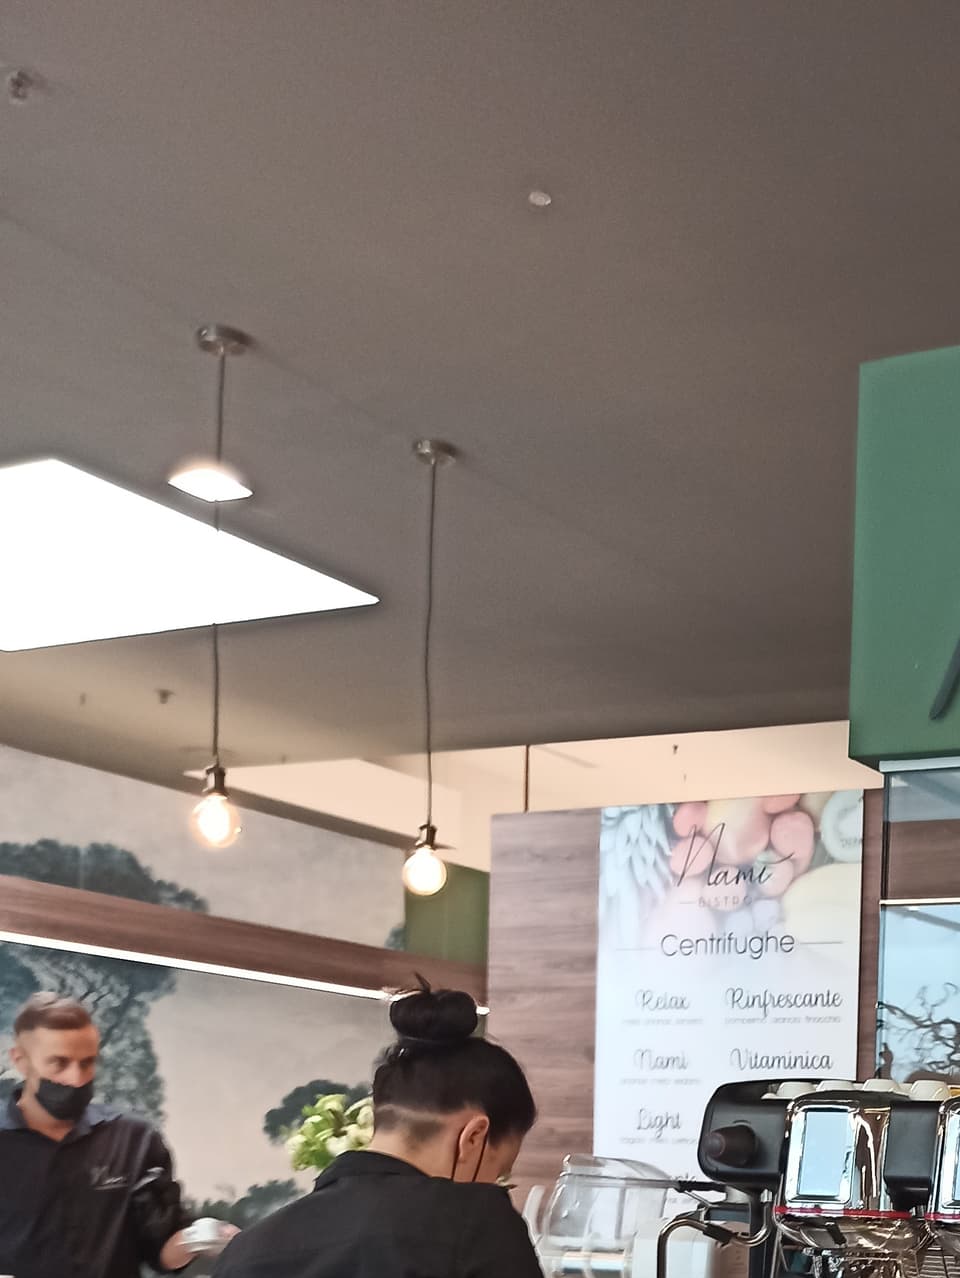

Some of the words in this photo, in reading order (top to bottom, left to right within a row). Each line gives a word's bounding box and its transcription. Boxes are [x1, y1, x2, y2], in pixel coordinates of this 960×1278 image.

[677, 822, 795, 888] Nami
[660, 931, 796, 960] Centrifughe
[635, 989, 691, 1012] Relax
[725, 986, 843, 1019] Rinfrescante
[633, 1048, 689, 1071] Nami
[729, 1048, 834, 1071] Vitaminica
[636, 1108, 681, 1139] Light
